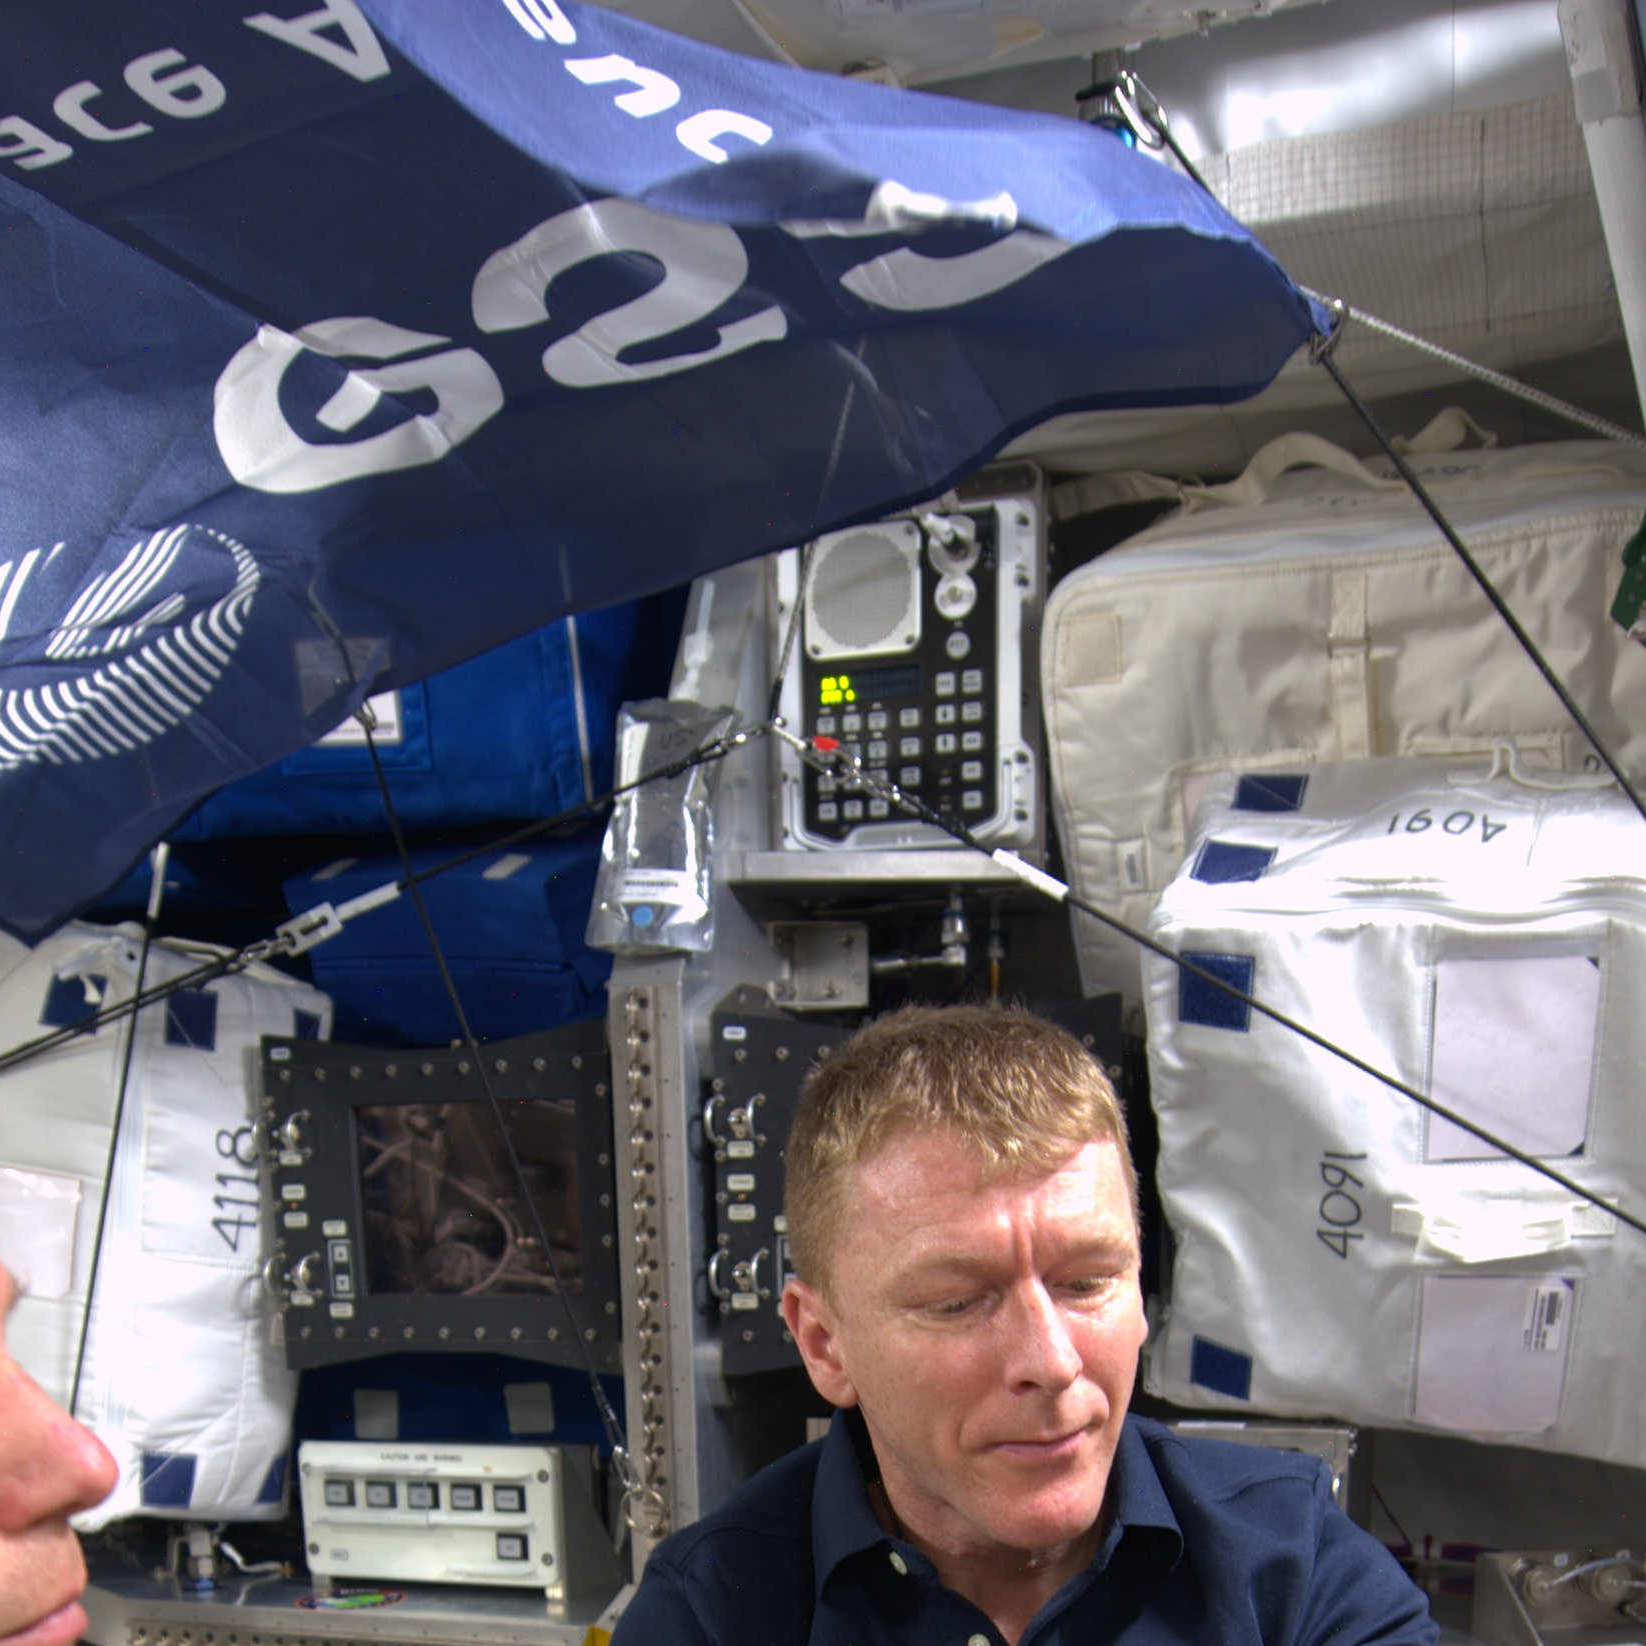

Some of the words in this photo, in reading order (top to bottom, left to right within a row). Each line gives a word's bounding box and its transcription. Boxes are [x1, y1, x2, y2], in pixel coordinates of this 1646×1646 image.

[1387, 810, 1507, 843] 4091
[211, 1126, 258, 1254] 4118
[1316, 1151, 1369, 1260] 4091
